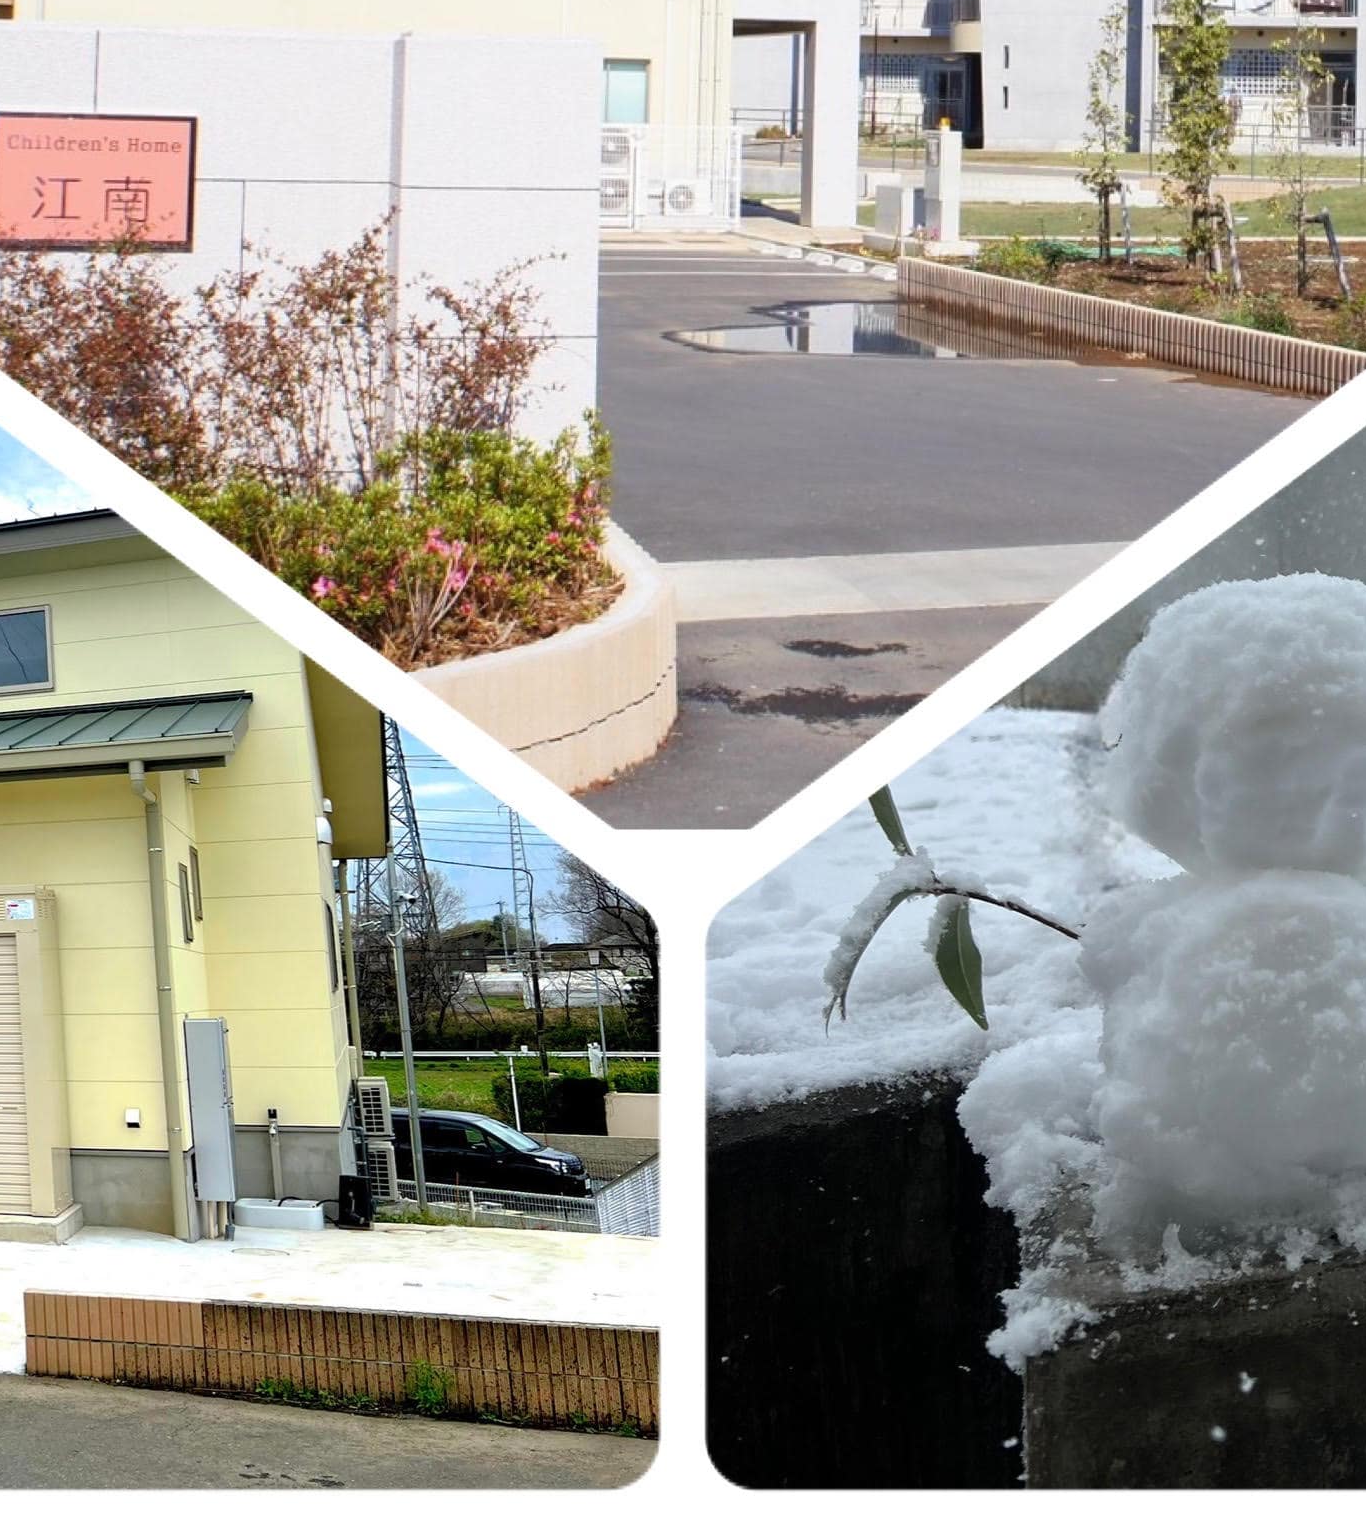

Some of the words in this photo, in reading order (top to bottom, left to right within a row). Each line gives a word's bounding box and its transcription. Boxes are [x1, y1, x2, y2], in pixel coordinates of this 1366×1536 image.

[7, 134, 119, 152] Children's
[127, 138, 182, 153] Home
[32, 176, 152, 223] 江南
